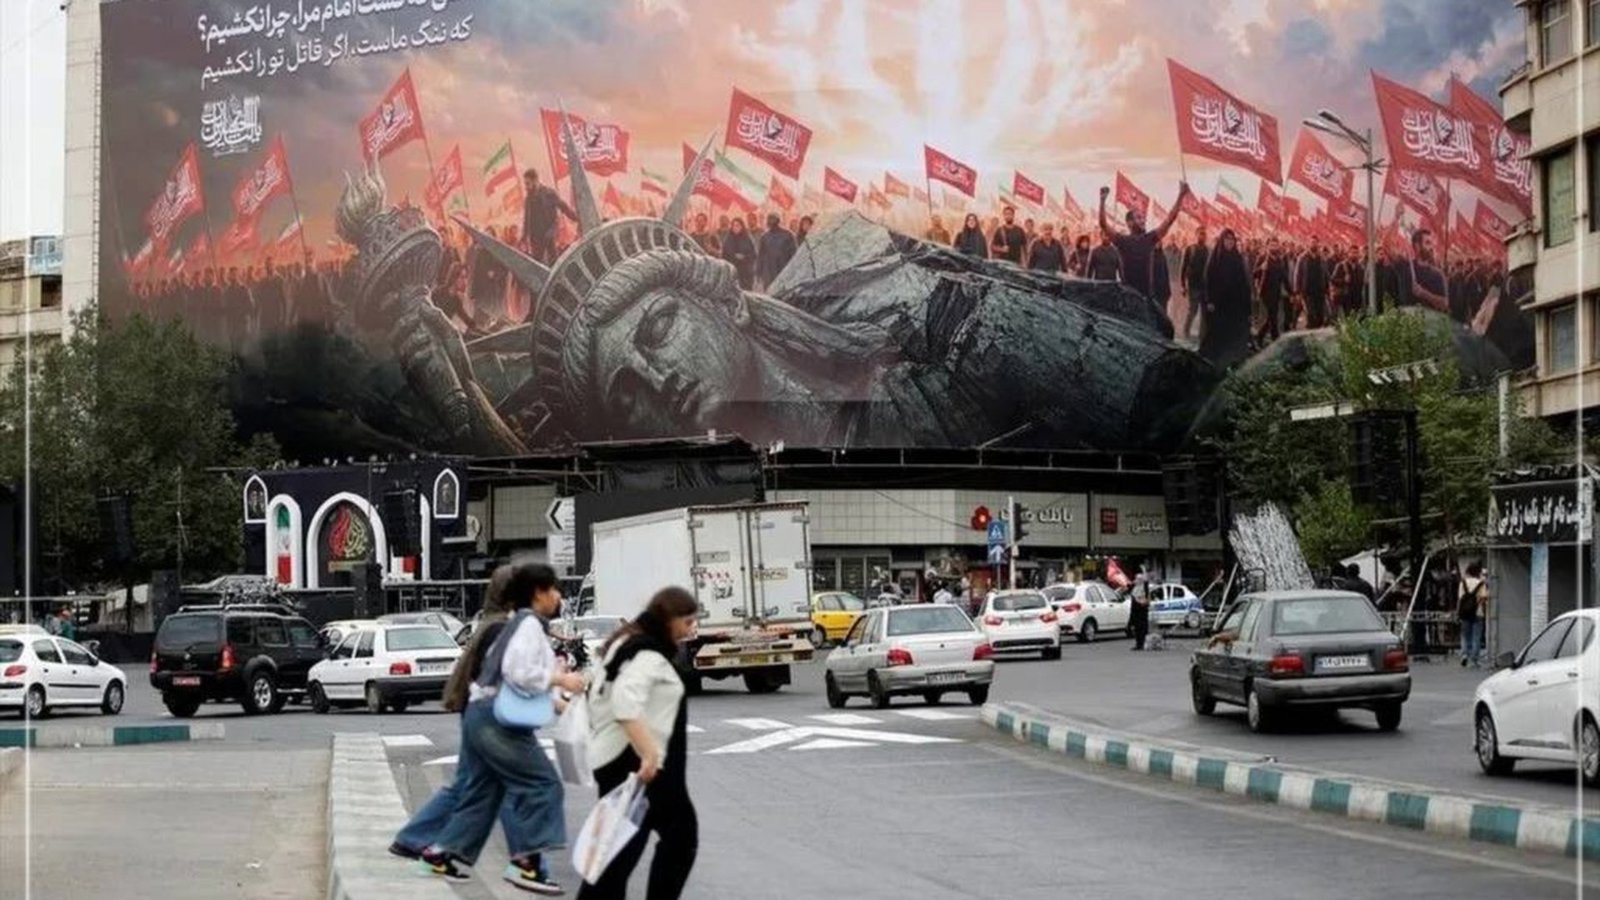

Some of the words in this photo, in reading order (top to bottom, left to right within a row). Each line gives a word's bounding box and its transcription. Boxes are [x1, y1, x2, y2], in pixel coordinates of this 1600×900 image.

[197, 5, 265, 53] نکشیم؟
[266, 3, 291, 38] چرا
[411, 20, 447, 46] ننگ
[450, 14, 473, 39] که
[286, 38, 322, 73] قاتل
[323, 31, 349, 67] اگر
[200, 50, 255, 90] نکشیم
